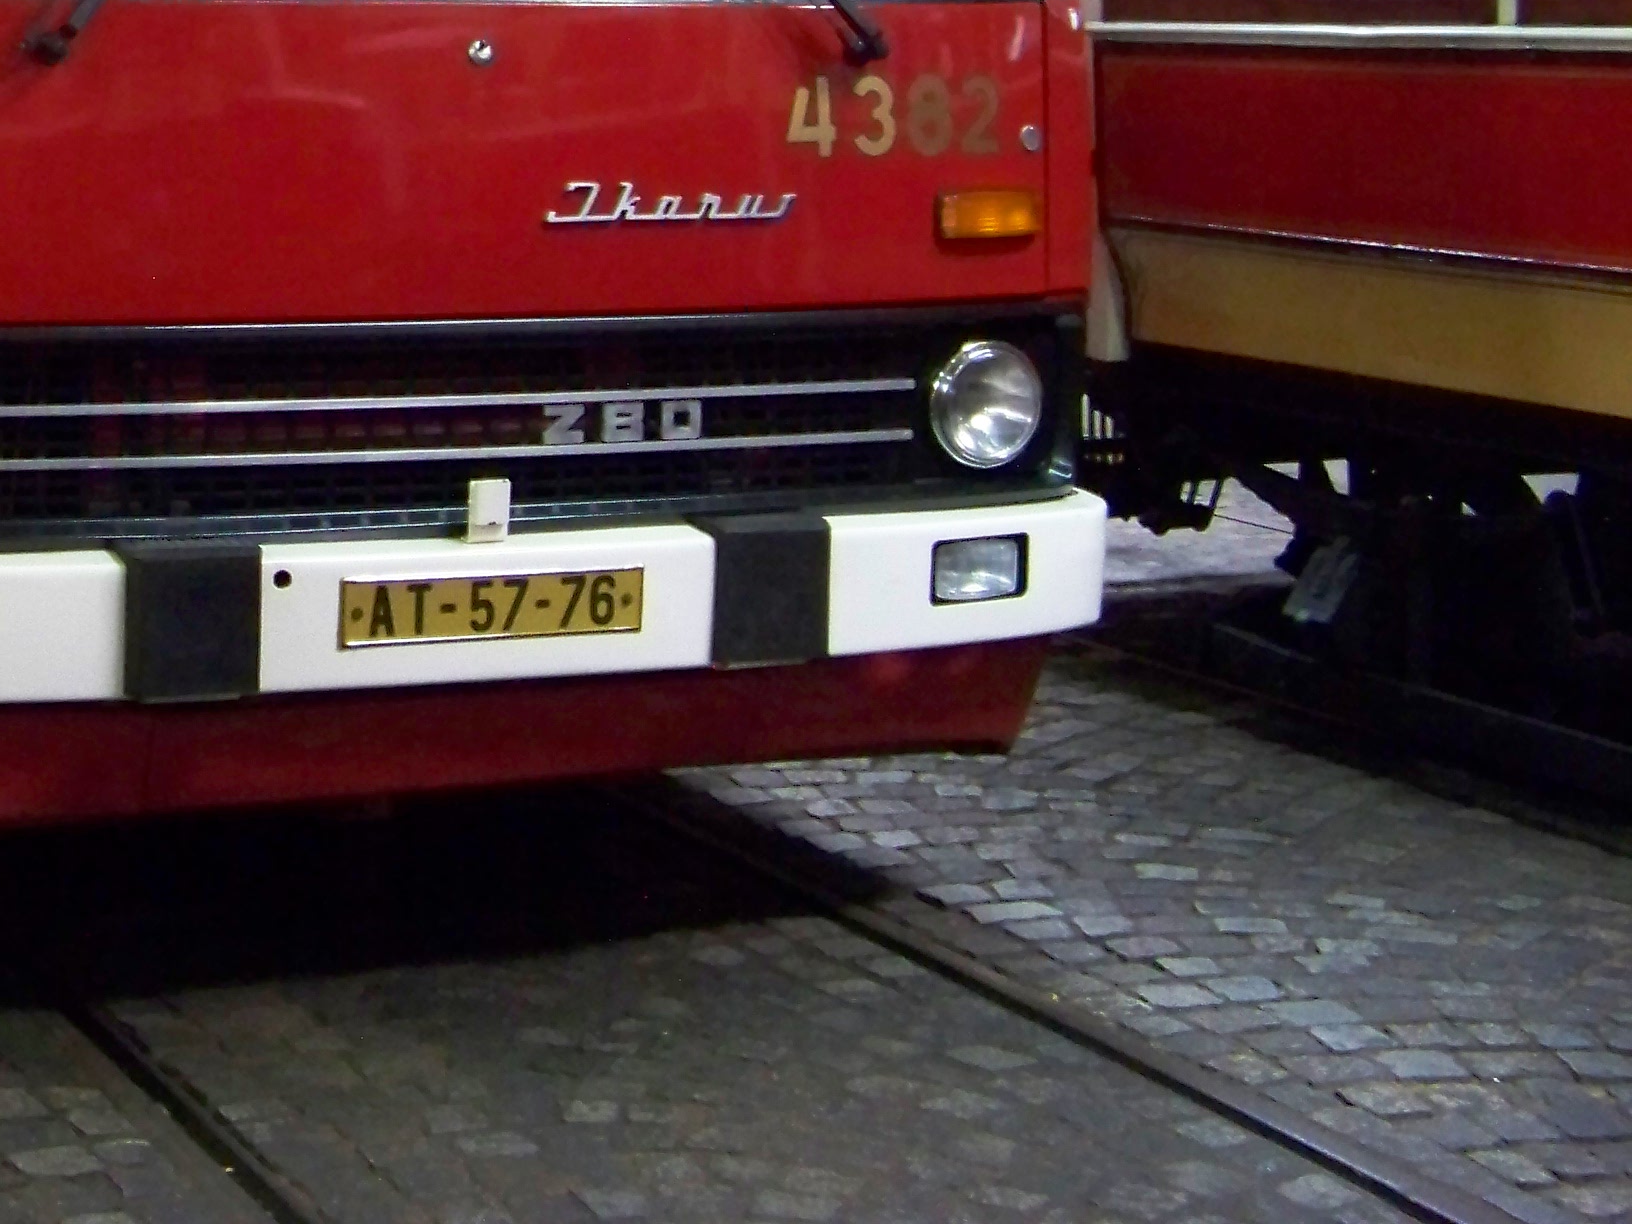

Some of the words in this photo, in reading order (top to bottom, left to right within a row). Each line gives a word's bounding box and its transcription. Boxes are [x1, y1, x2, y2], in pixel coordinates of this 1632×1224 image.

[786, 75, 1000, 158] 4382
[544, 181, 797, 224] Ikarus
[369, 575, 616, 638] AT-57-76
